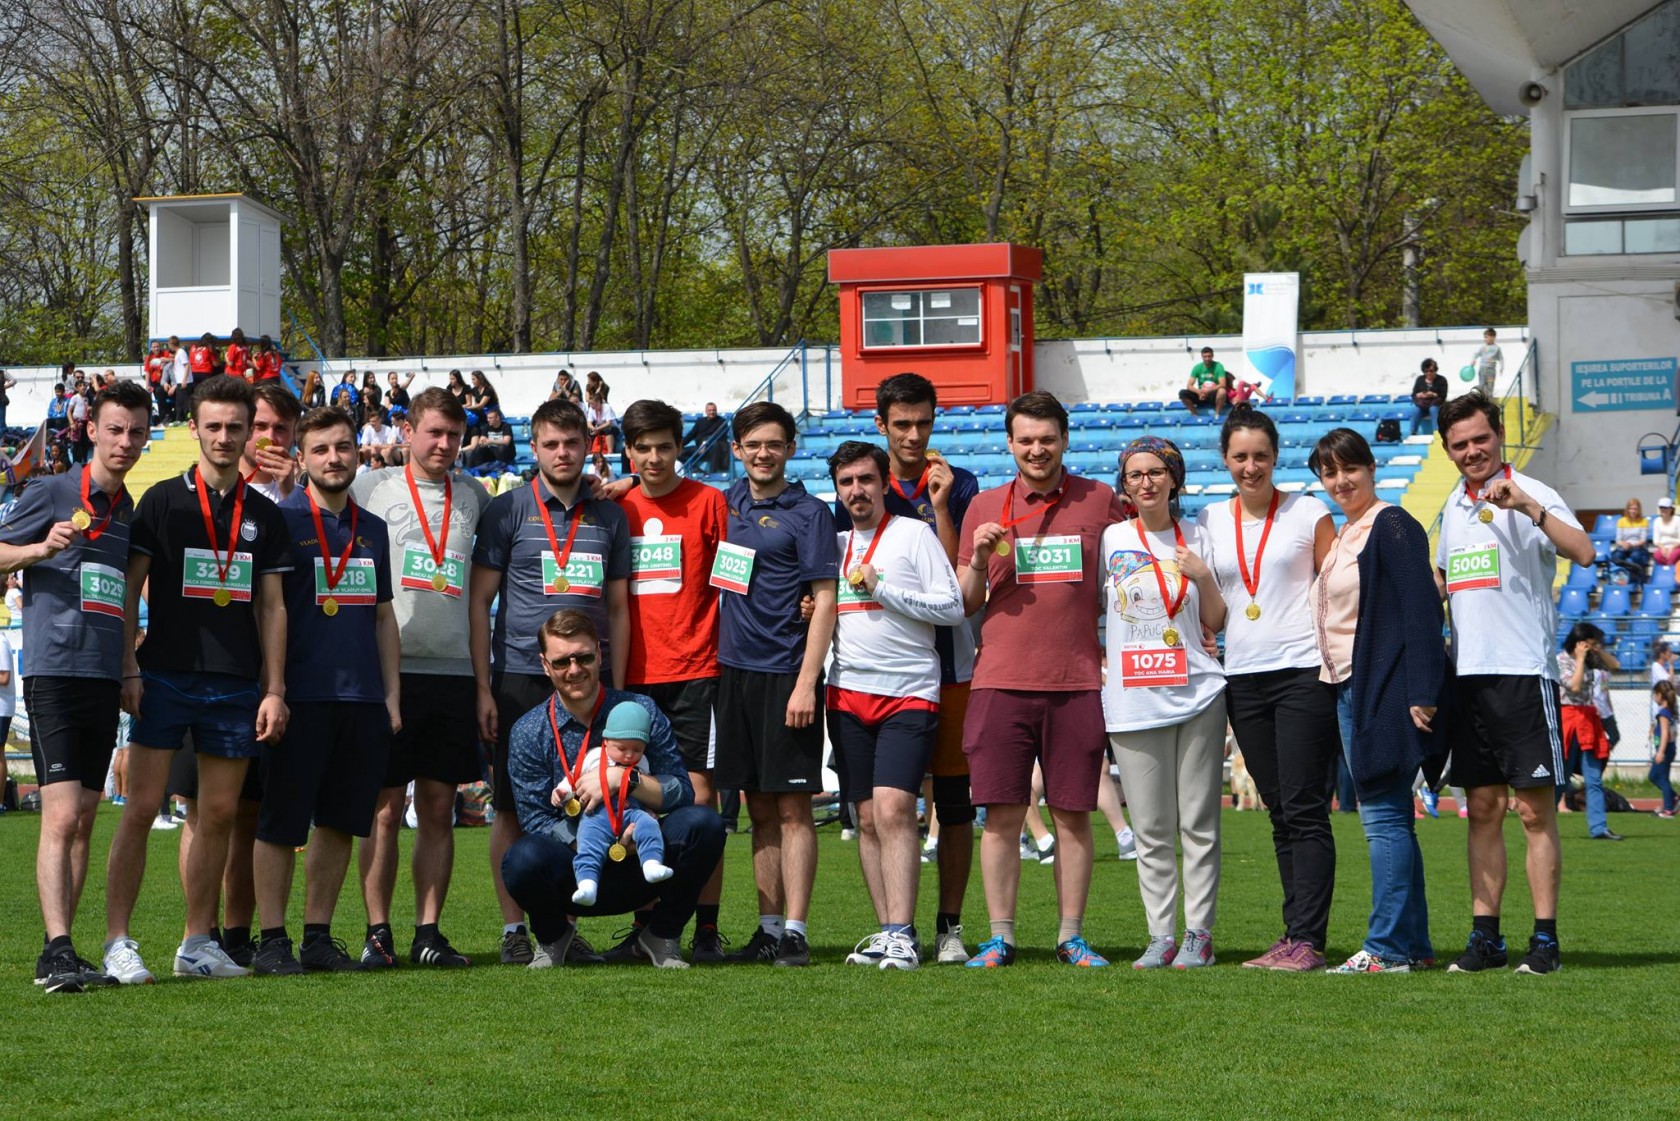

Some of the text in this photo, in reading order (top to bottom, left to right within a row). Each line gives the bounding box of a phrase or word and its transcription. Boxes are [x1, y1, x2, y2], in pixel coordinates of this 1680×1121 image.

[1610, 361, 1673, 372] SUPORTERILOR
[1581, 378, 1592, 388] PE
[1594, 378, 1605, 387] LA
[1643, 376, 1655, 385] DE
[1656, 376, 1668, 385] LA
[1624, 388, 1672, 402] TRIBUNA A
[631, 546, 674, 563] 3048
[1026, 548, 1071, 565] 3031
[720, 554, 748, 575] 3025
[1452, 554, 1491, 574] 5006
[331, 570, 366, 586] 218
[90, 576, 124, 599] 3029
[1131, 652, 1177, 670] 1075
